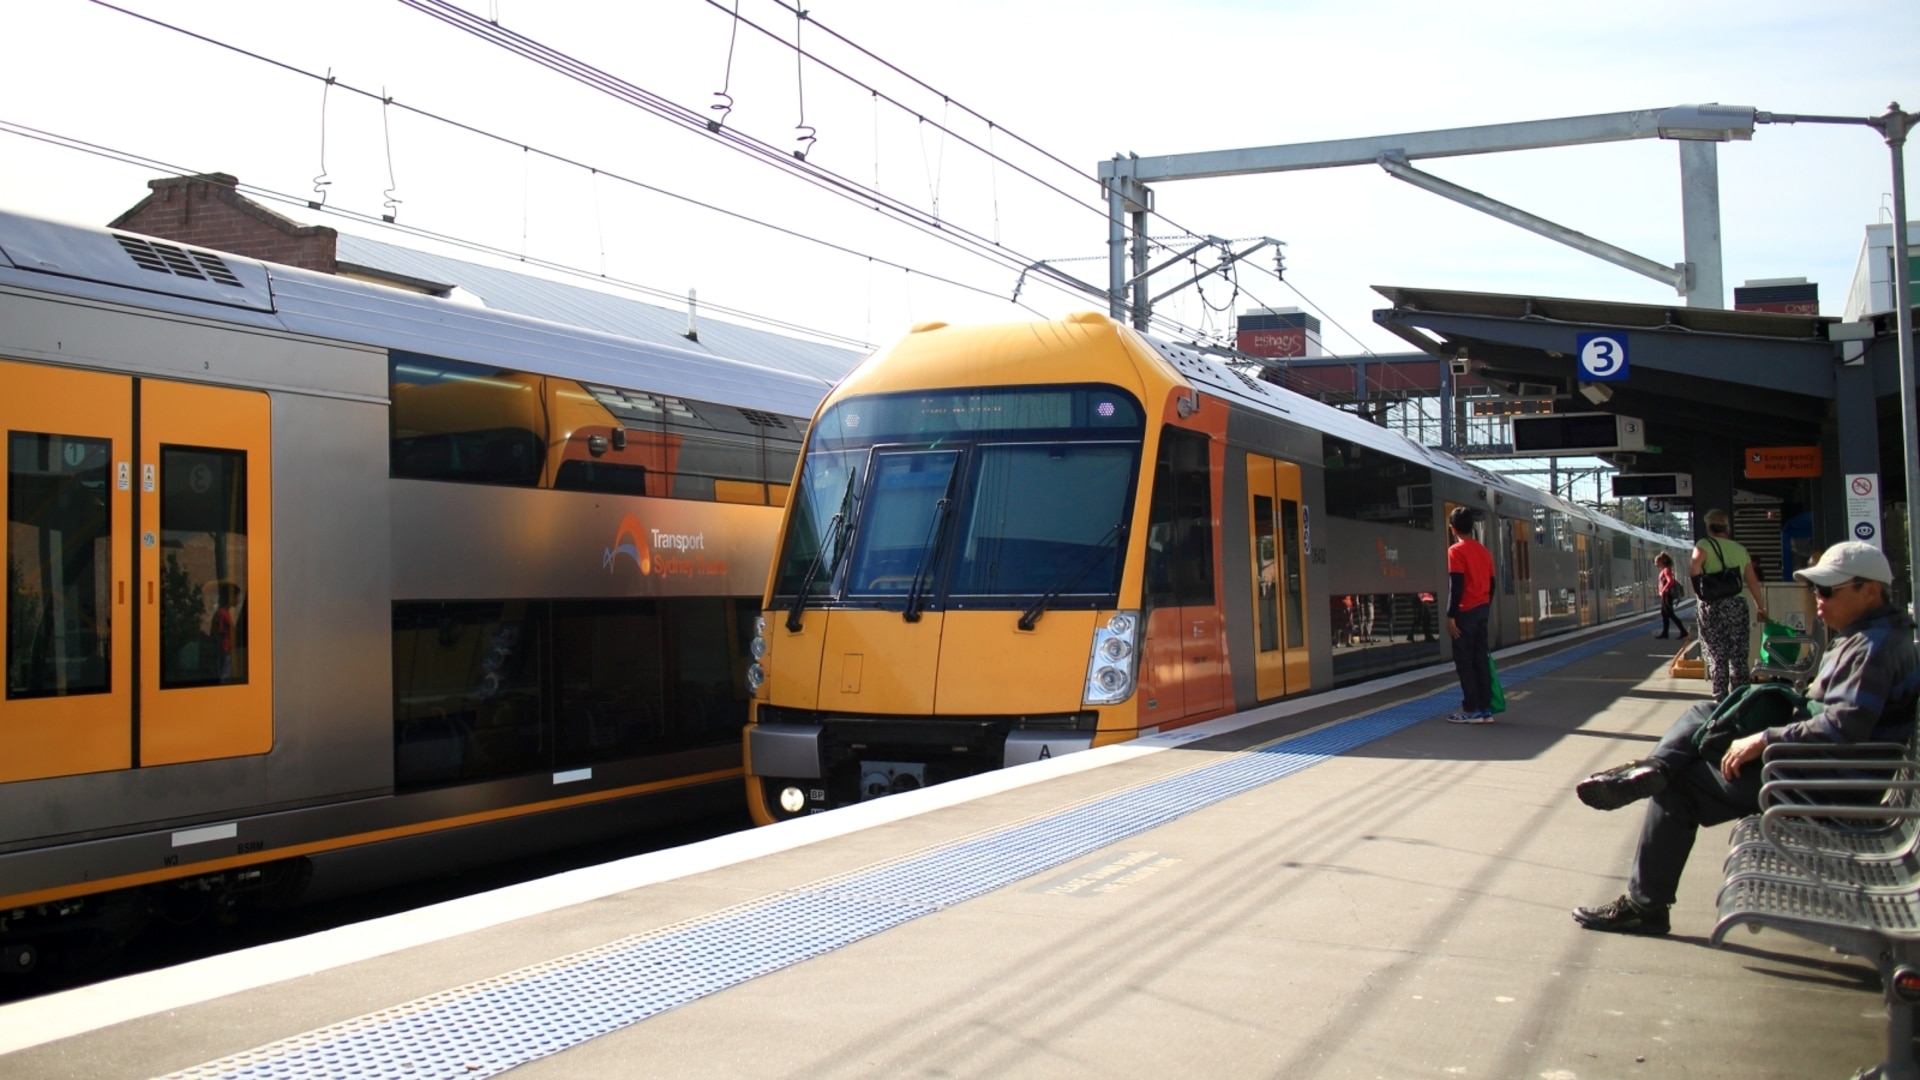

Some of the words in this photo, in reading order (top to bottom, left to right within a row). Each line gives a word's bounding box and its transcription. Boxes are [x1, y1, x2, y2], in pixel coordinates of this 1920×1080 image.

[57, 341, 62, 350] 1
[1593, 339, 1615, 373] 3
[204, 361, 210, 370] 3
[1627, 423, 1636, 432] 3
[1764, 454, 1816, 464] Emergency
[1764, 463, 1786, 472] Help
[1789, 462, 1814, 470] Point
[651, 528, 704, 553] Transport
[653, 554, 694, 578] Sydney
[1038, 744, 1052, 760] A
[811, 790, 823, 799] BP
[237, 841, 264, 854] BSRM
[163, 854, 179, 867] W3
